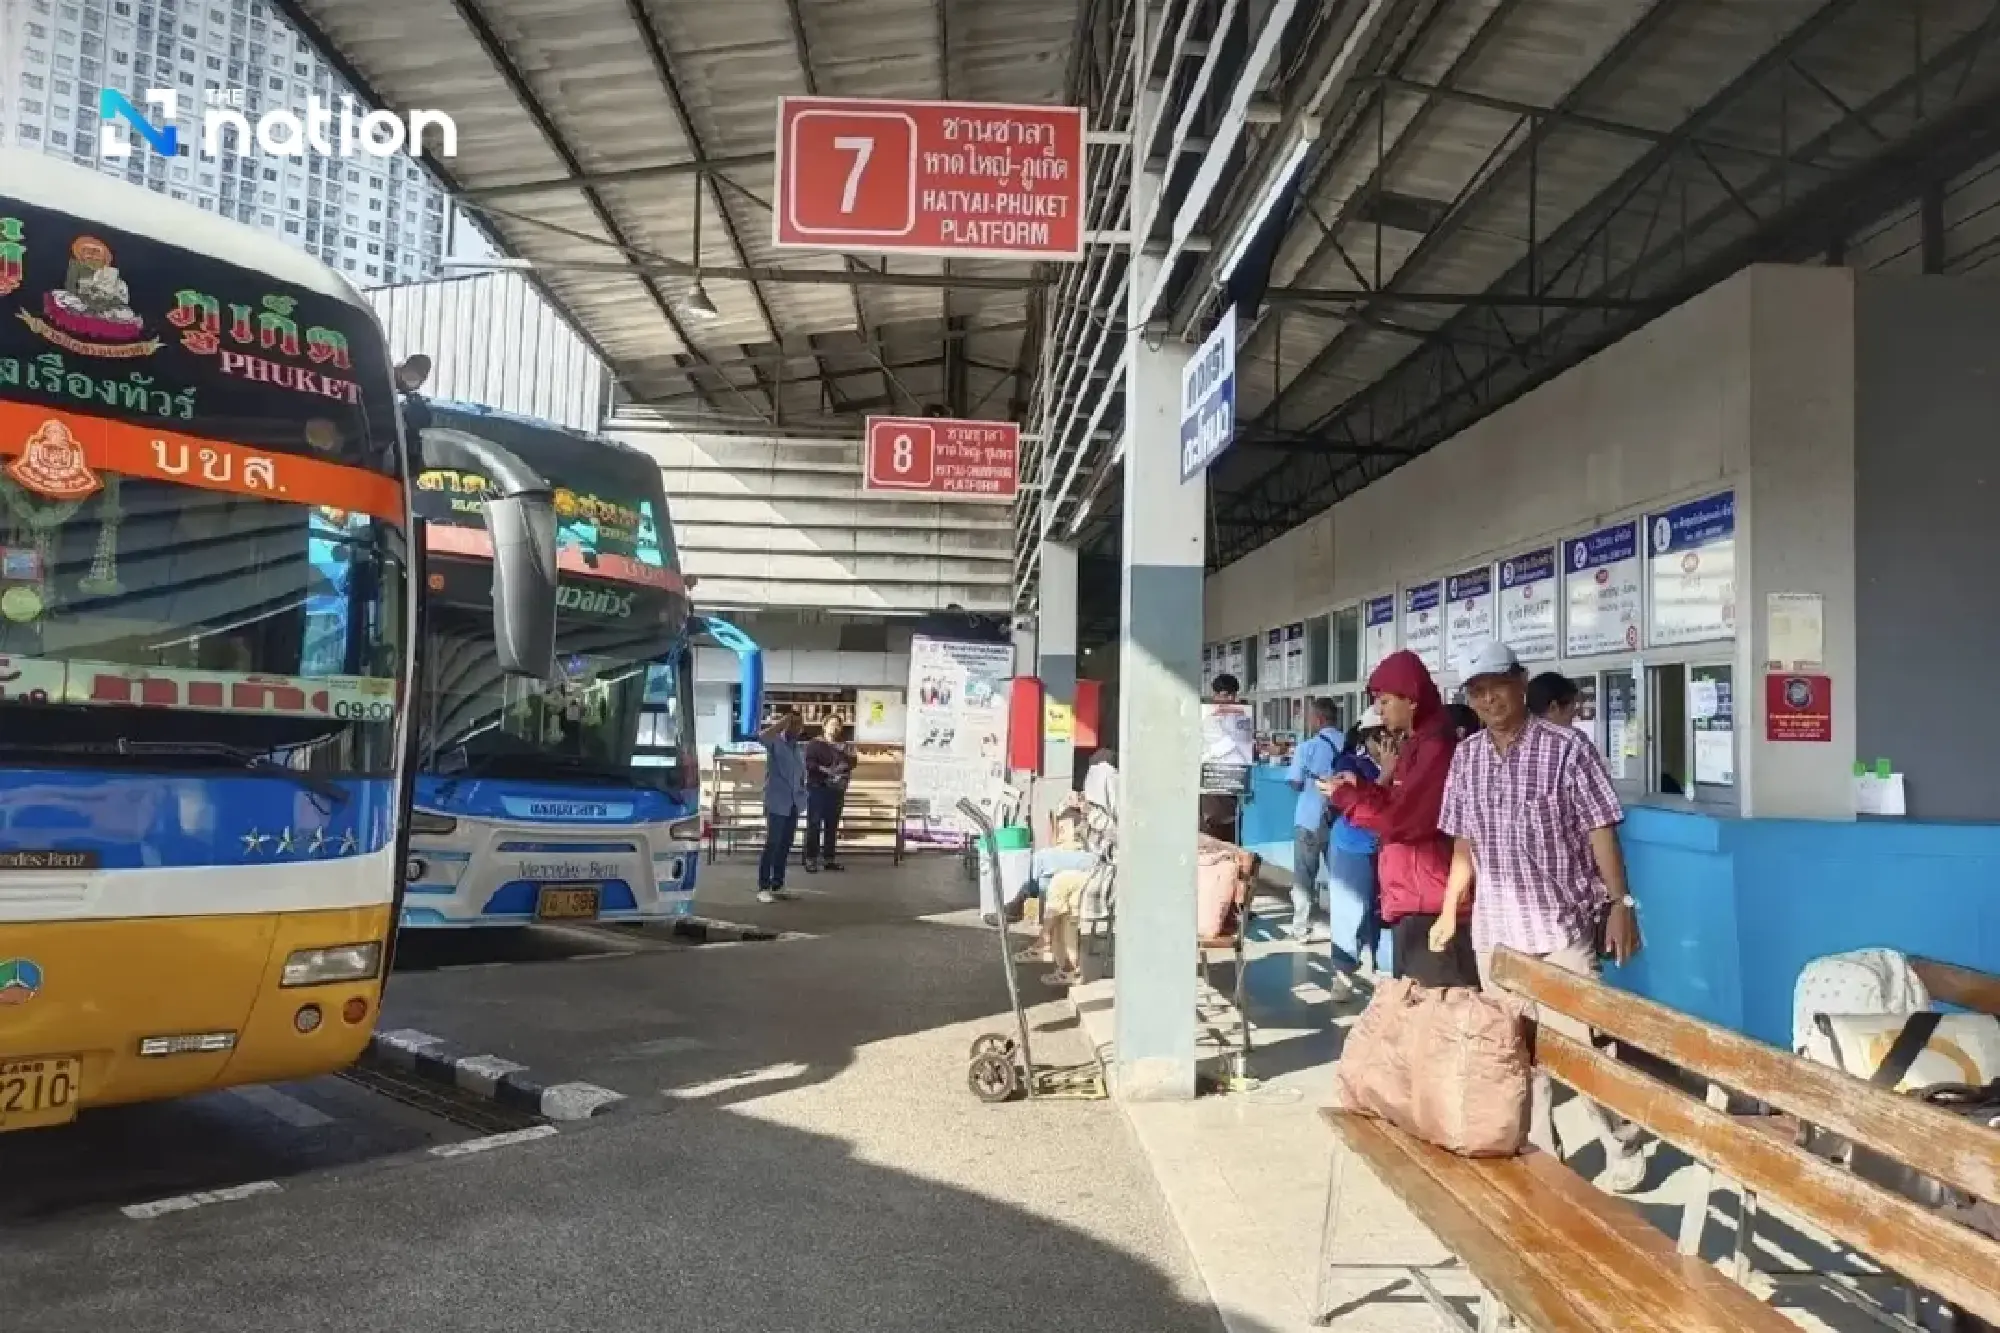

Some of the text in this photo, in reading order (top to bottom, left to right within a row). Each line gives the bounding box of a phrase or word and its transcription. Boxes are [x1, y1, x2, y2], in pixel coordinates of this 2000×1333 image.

[943, 118, 1056, 148] ชานชาลา
[834, 136, 875, 214] 7
[924, 144, 1069, 191] หาดใหญ่-ภูเก็ต
[923, 190, 1069, 218] HATYAI-PHUKET
[941, 219, 1049, 245] PLATFORM
[166, 288, 350, 370] ภูเก็ต
[219, 350, 362, 404] PHUKET
[151, 440, 287, 493] บขส.
[893, 434, 912, 474] 8
